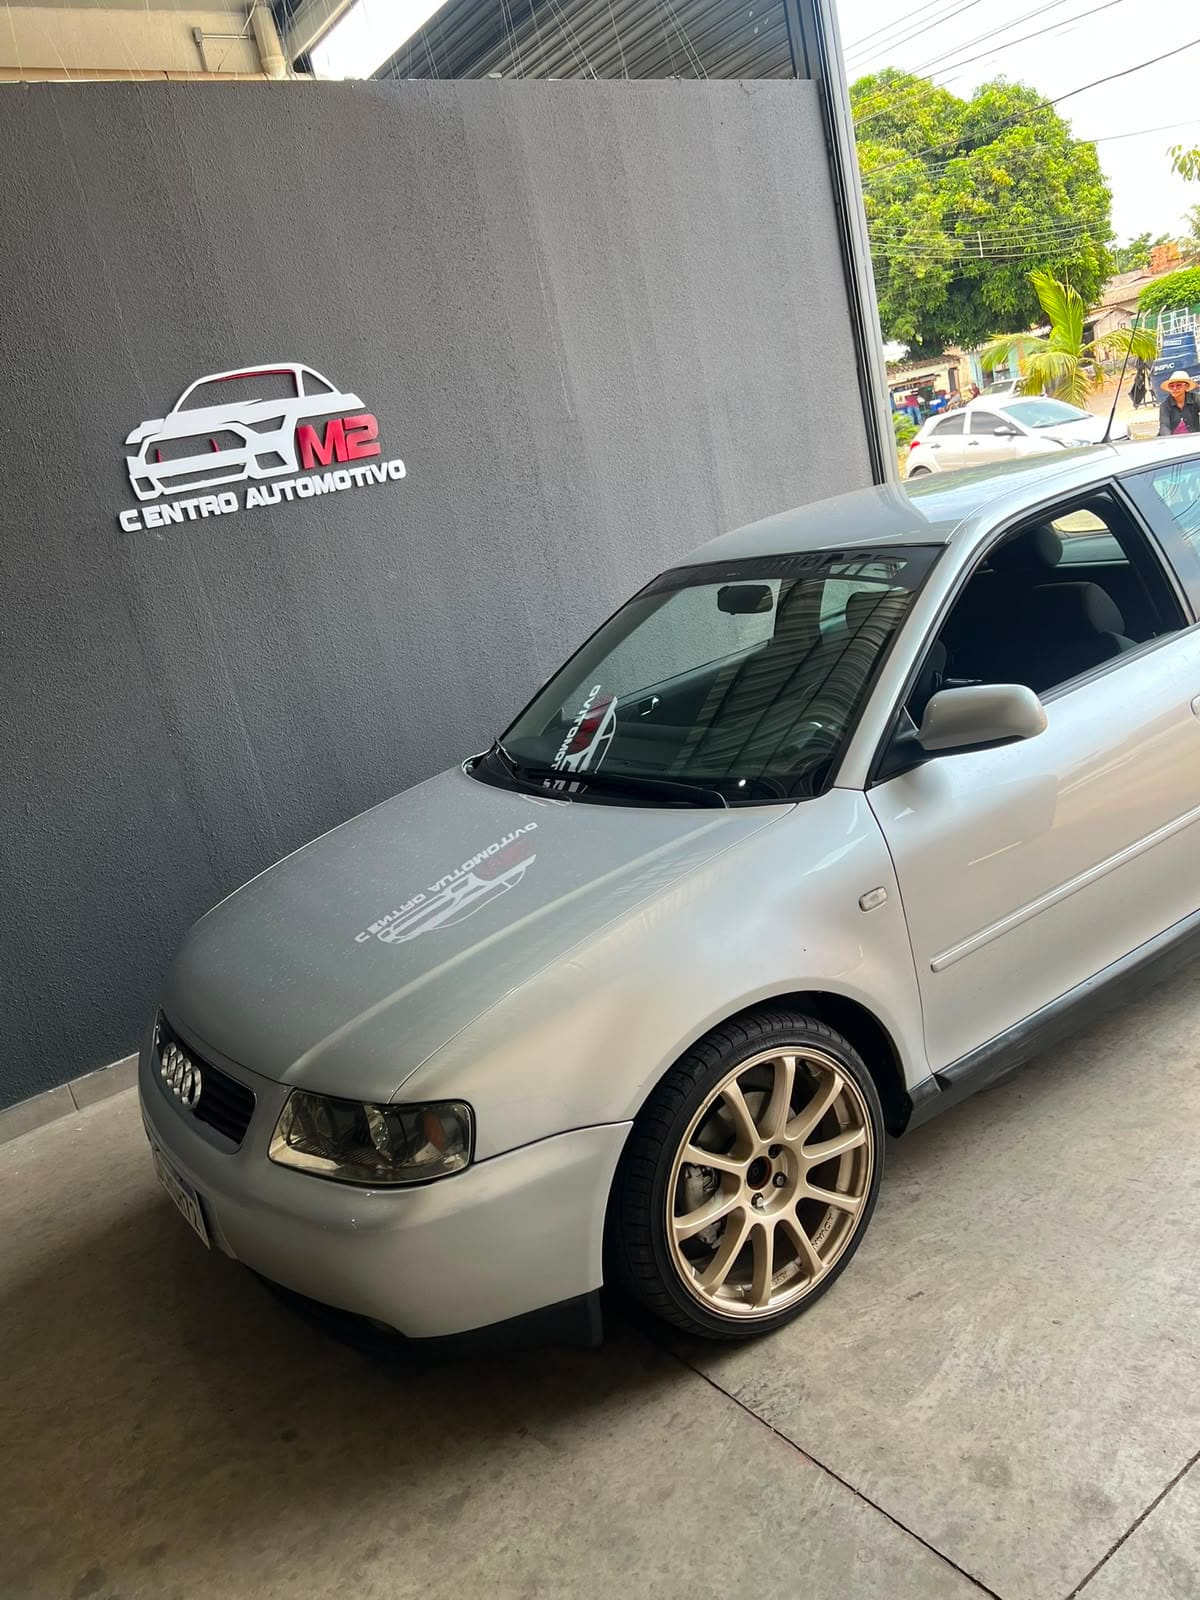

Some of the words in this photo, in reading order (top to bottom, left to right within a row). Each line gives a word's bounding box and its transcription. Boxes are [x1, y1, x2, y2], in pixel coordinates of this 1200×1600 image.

[297, 413, 381, 470] M2
[119, 492, 239, 533] CENTRO
[246, 459, 407, 509] AUTOMOTIVO
